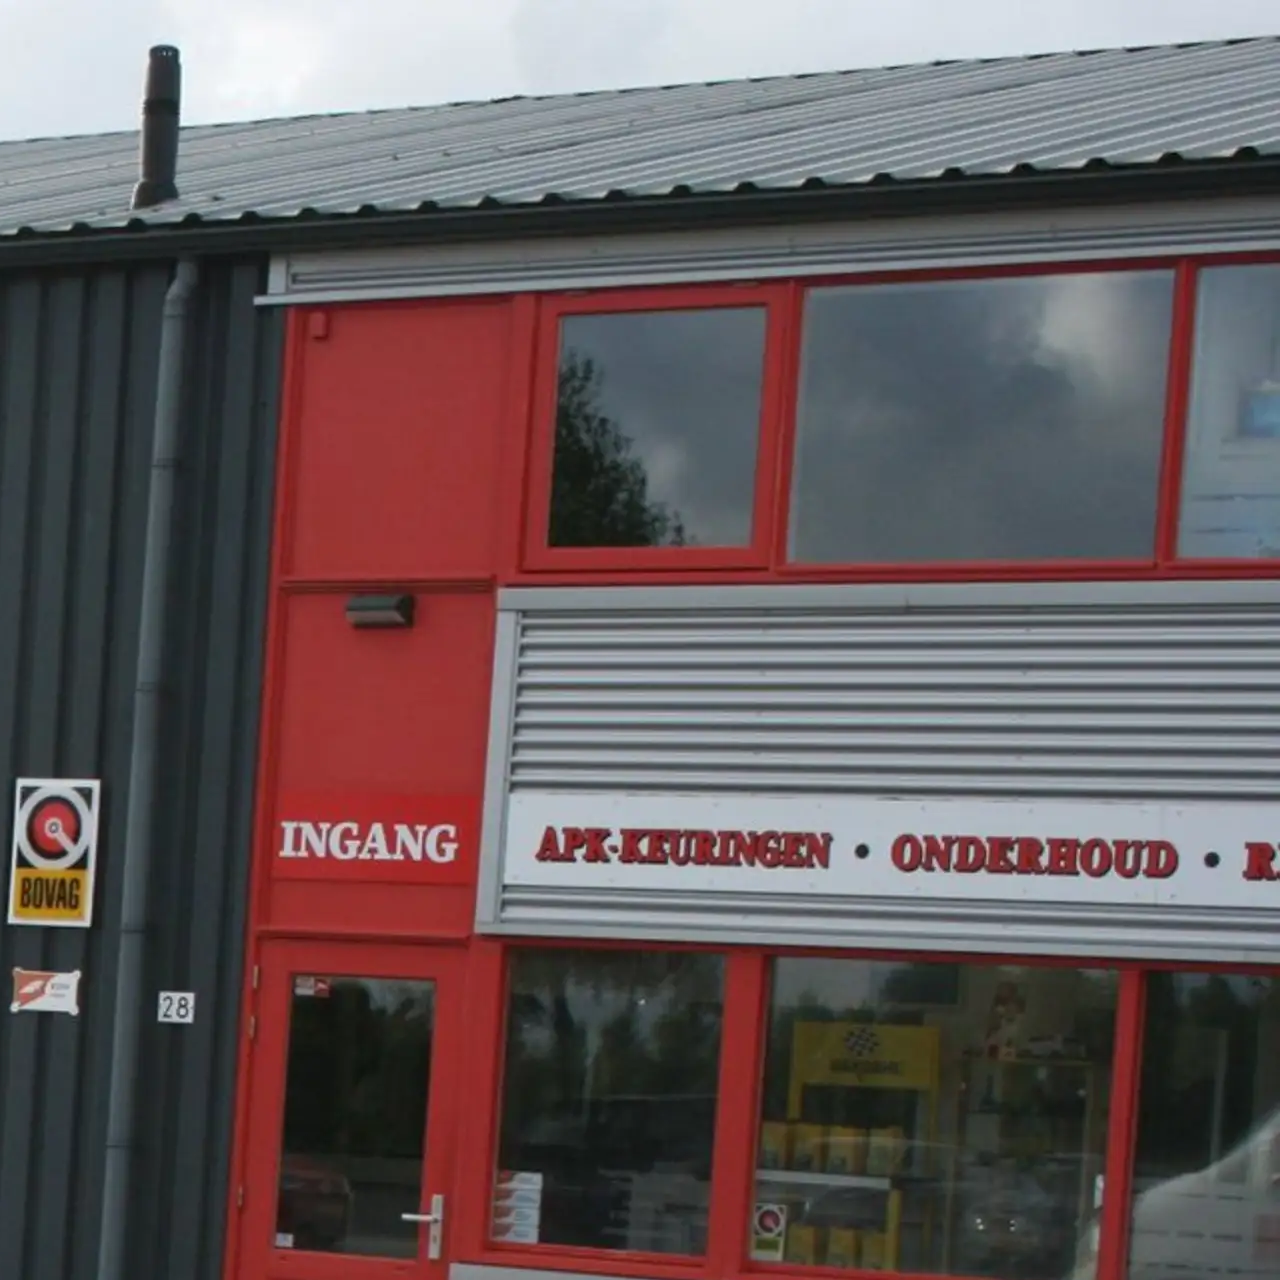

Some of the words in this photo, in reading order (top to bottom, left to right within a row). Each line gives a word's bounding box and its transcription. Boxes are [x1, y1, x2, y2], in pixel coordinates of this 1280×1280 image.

[279, 821, 458, 863] INGANG
[535, 826, 832, 869] APK-KEURINGEN
[891, 833, 1179, 878] ONDERHOUD
[20, 877, 81, 909] BOVAG
[162, 995, 190, 1019] 28
